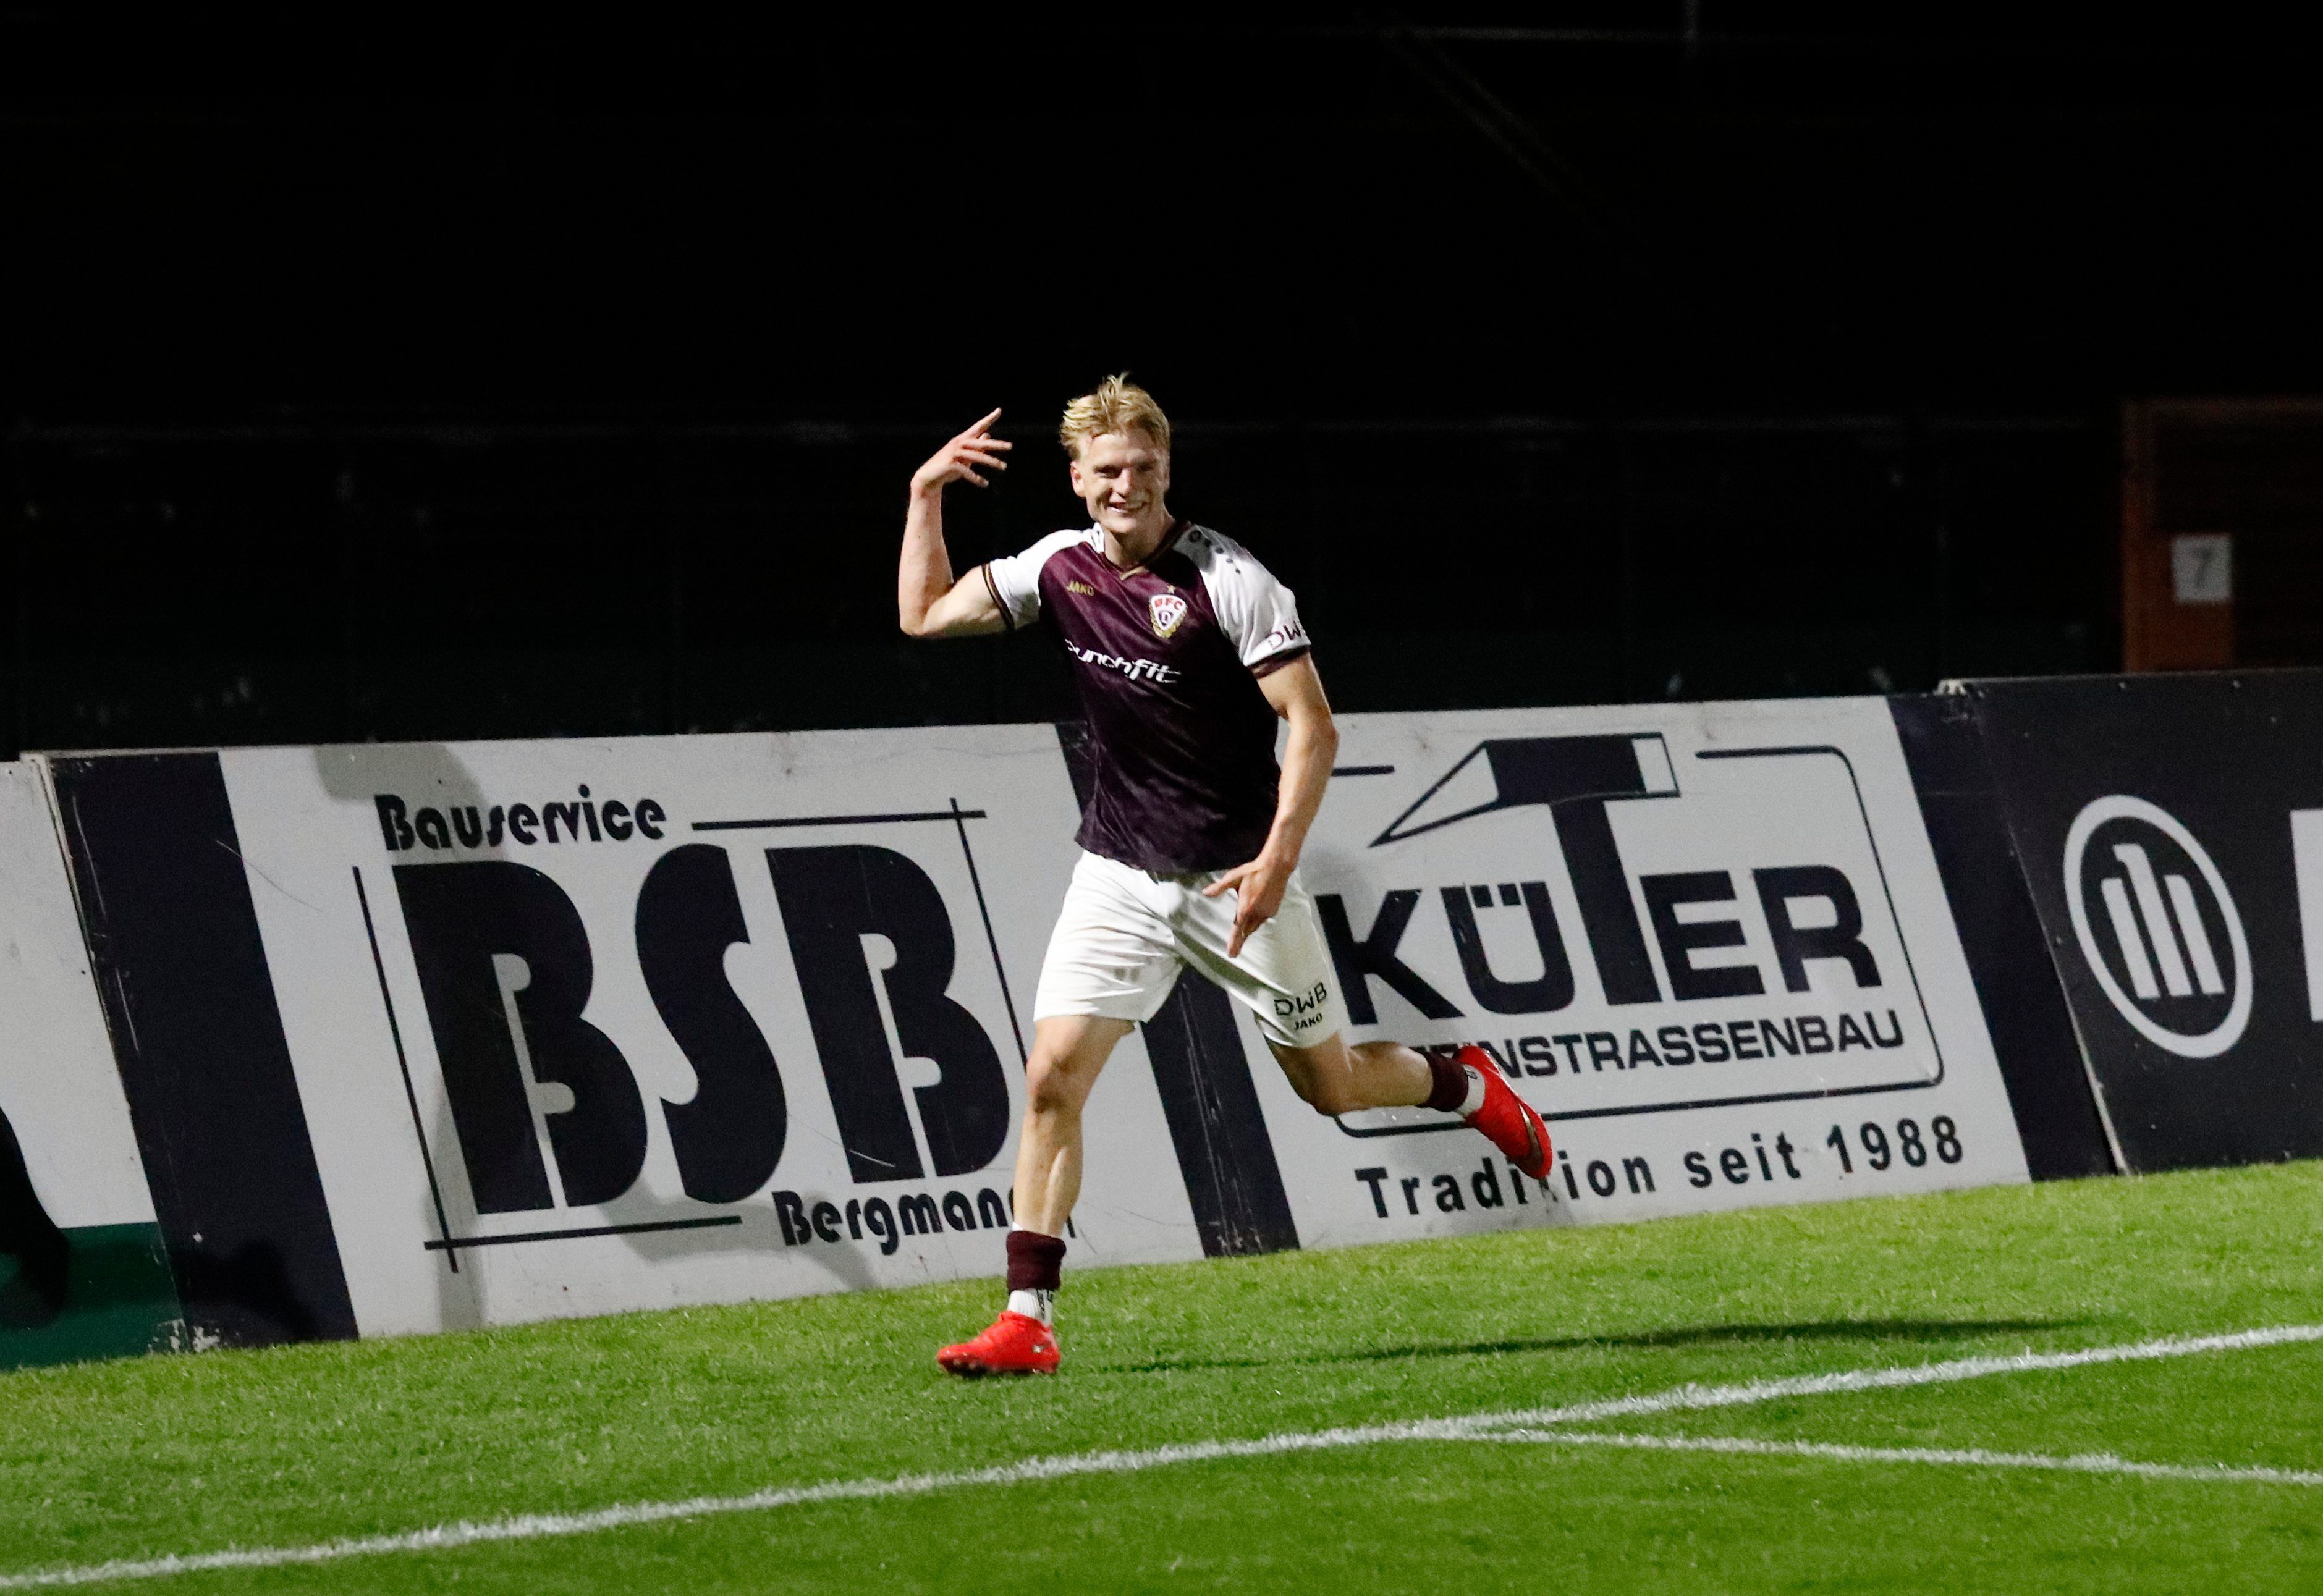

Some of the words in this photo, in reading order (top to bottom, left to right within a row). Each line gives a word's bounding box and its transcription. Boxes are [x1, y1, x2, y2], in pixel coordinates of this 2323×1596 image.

[1066, 580, 1094, 597] JAKO
[2191, 546, 2214, 588] 7
[1264, 620, 1306, 650] DW
[374, 783, 666, 851] Bauservice
[1314, 733, 1884, 1026] KÜTER
[391, 843, 1010, 1215] BSB
[1294, 1013, 1322, 1030] JAKO
[1409, 1008, 1903, 1079] NSTRASSENBAU
[1355, 1150, 1656, 1218] Tradiion
[1684, 1131, 1801, 1188] seit
[1826, 1115, 1963, 1175] 1988
[771, 1186, 1014, 1256] Bergman
